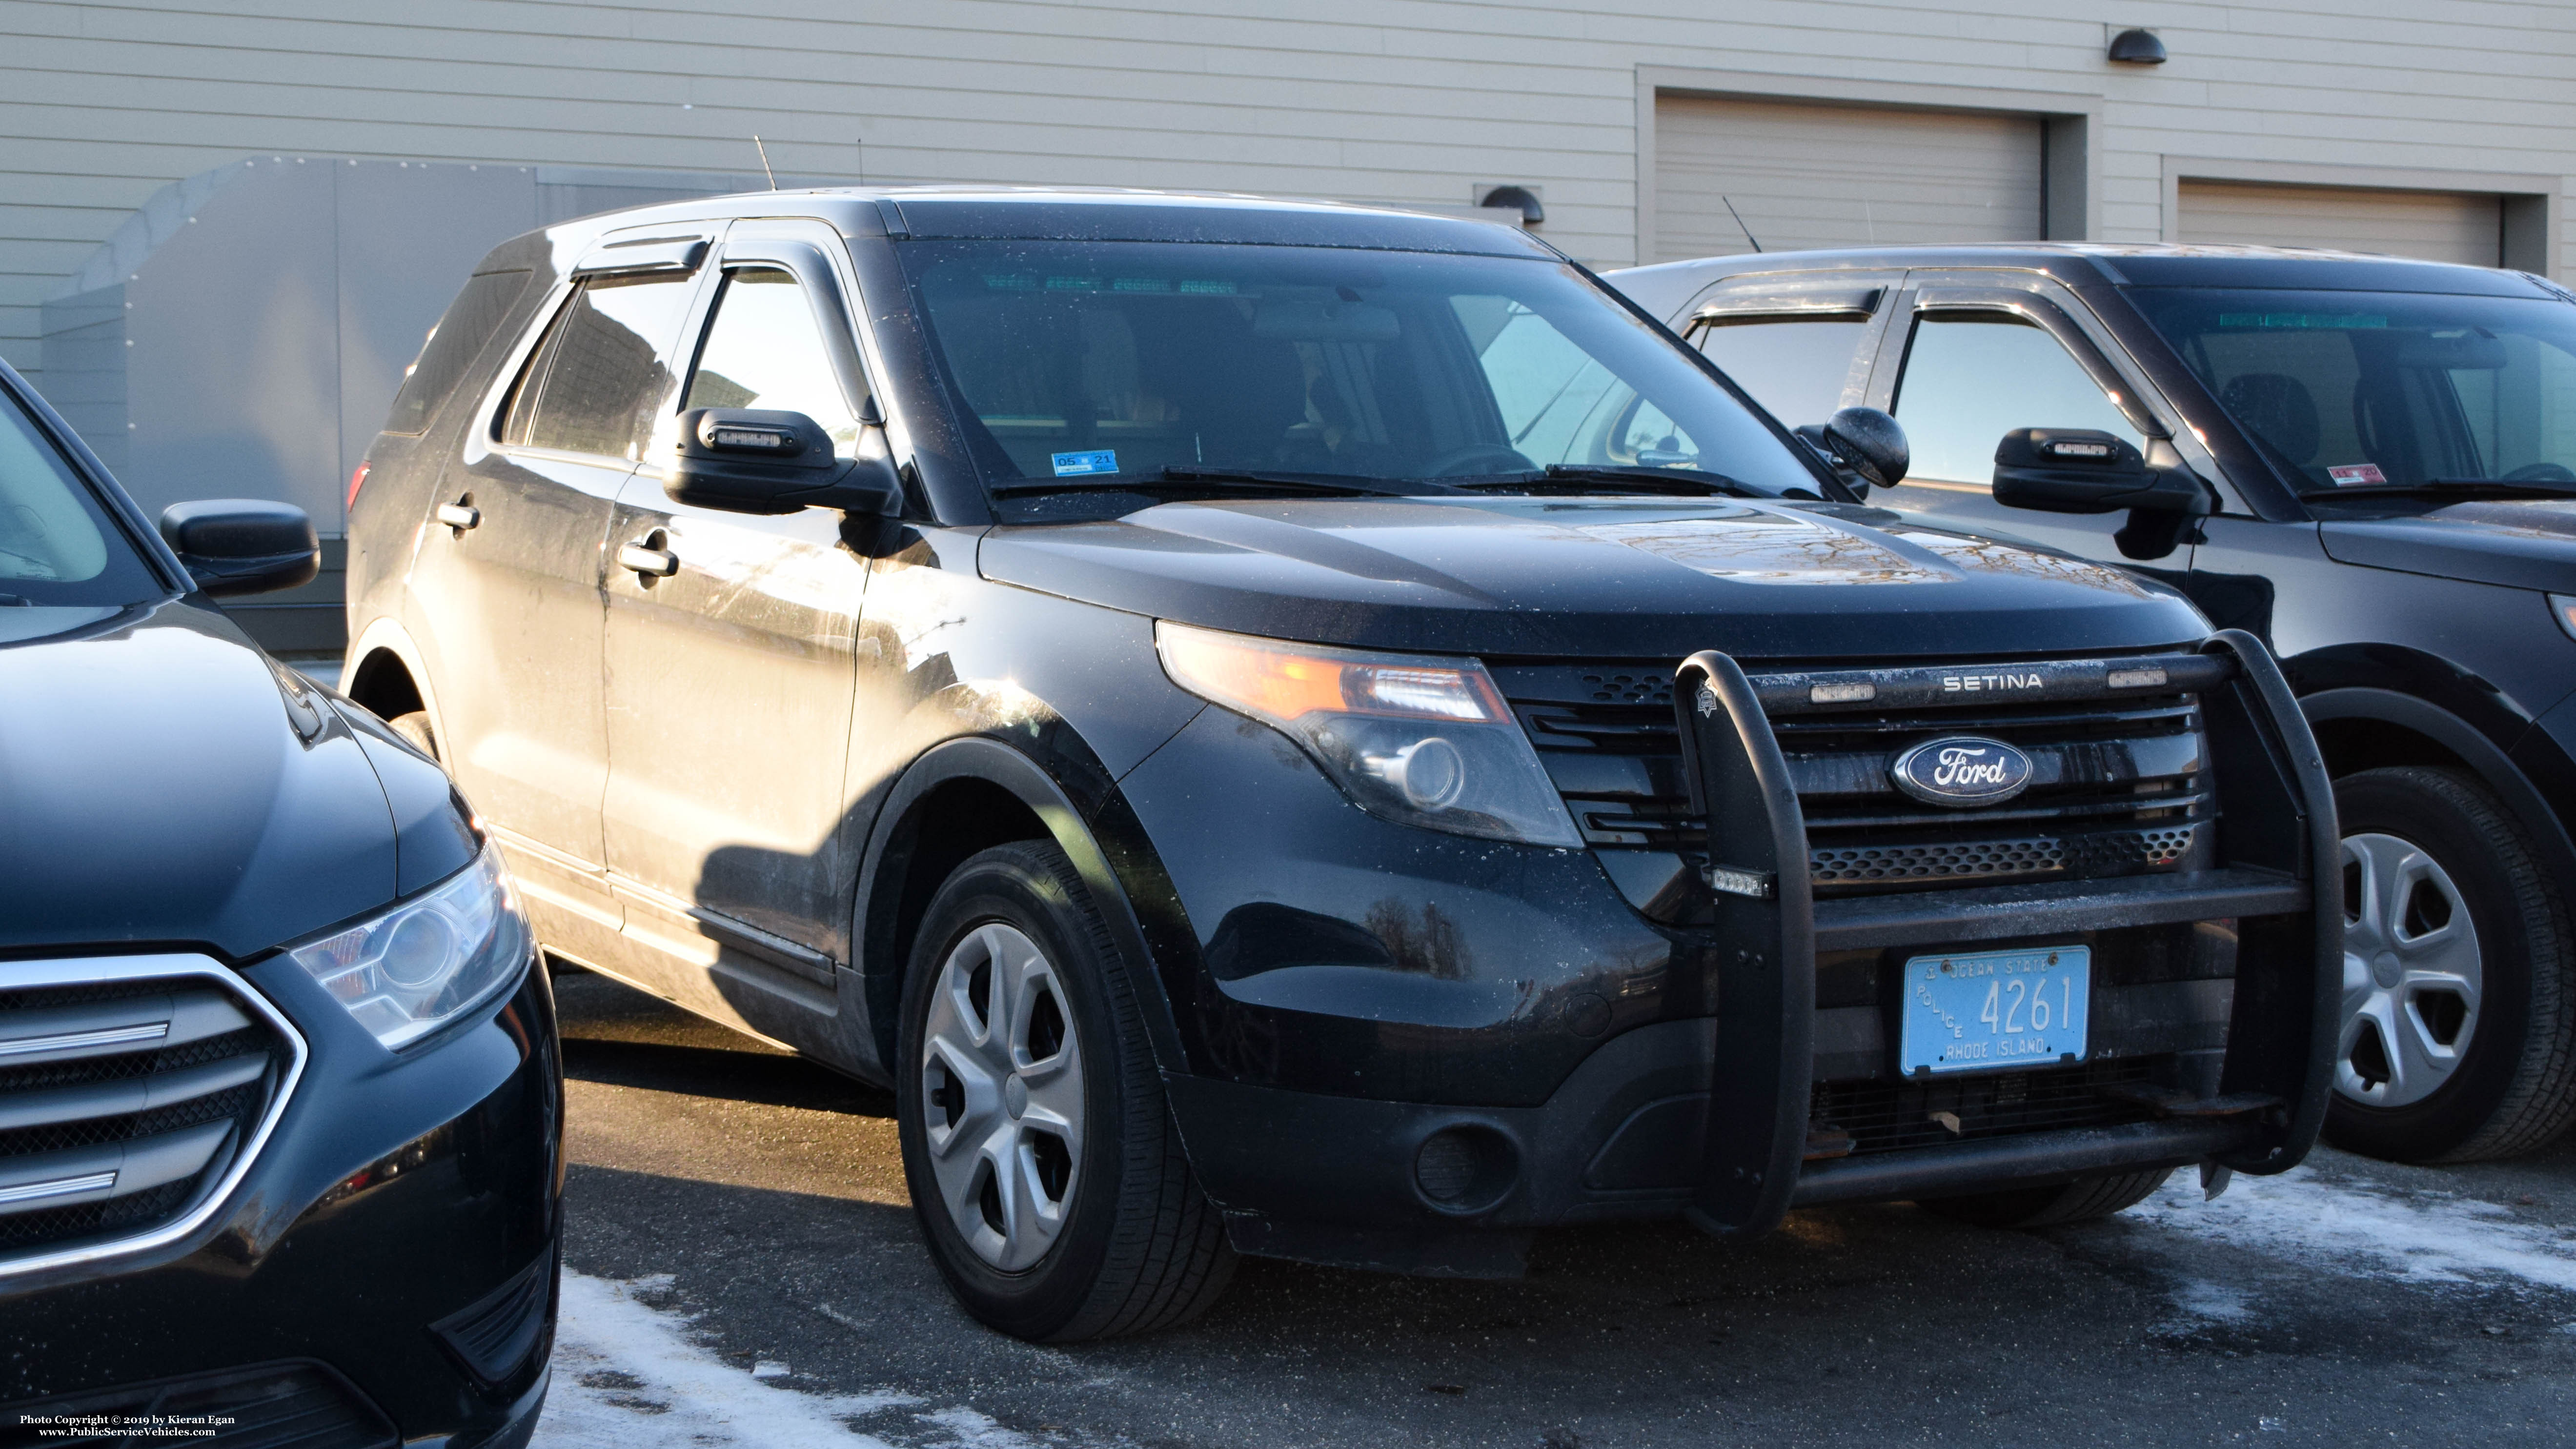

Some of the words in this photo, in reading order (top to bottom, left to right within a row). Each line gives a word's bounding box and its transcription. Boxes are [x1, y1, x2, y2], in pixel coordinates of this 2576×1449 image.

[1058, 457, 1076, 466] 05
[1095, 455, 1111, 463] 21
[1943, 673, 2043, 692] SETINA
[1934, 747, 2006, 785] Ford
[1950, 963, 1994, 979] OCEAN
[2006, 958, 2047, 974] STATE
[1917, 985, 1963, 1038] POLICE
[1981, 976, 2070, 1034] 4261
[1946, 1042, 1989, 1061] RHODE
[1997, 1038, 2044, 1056] ISLAND
